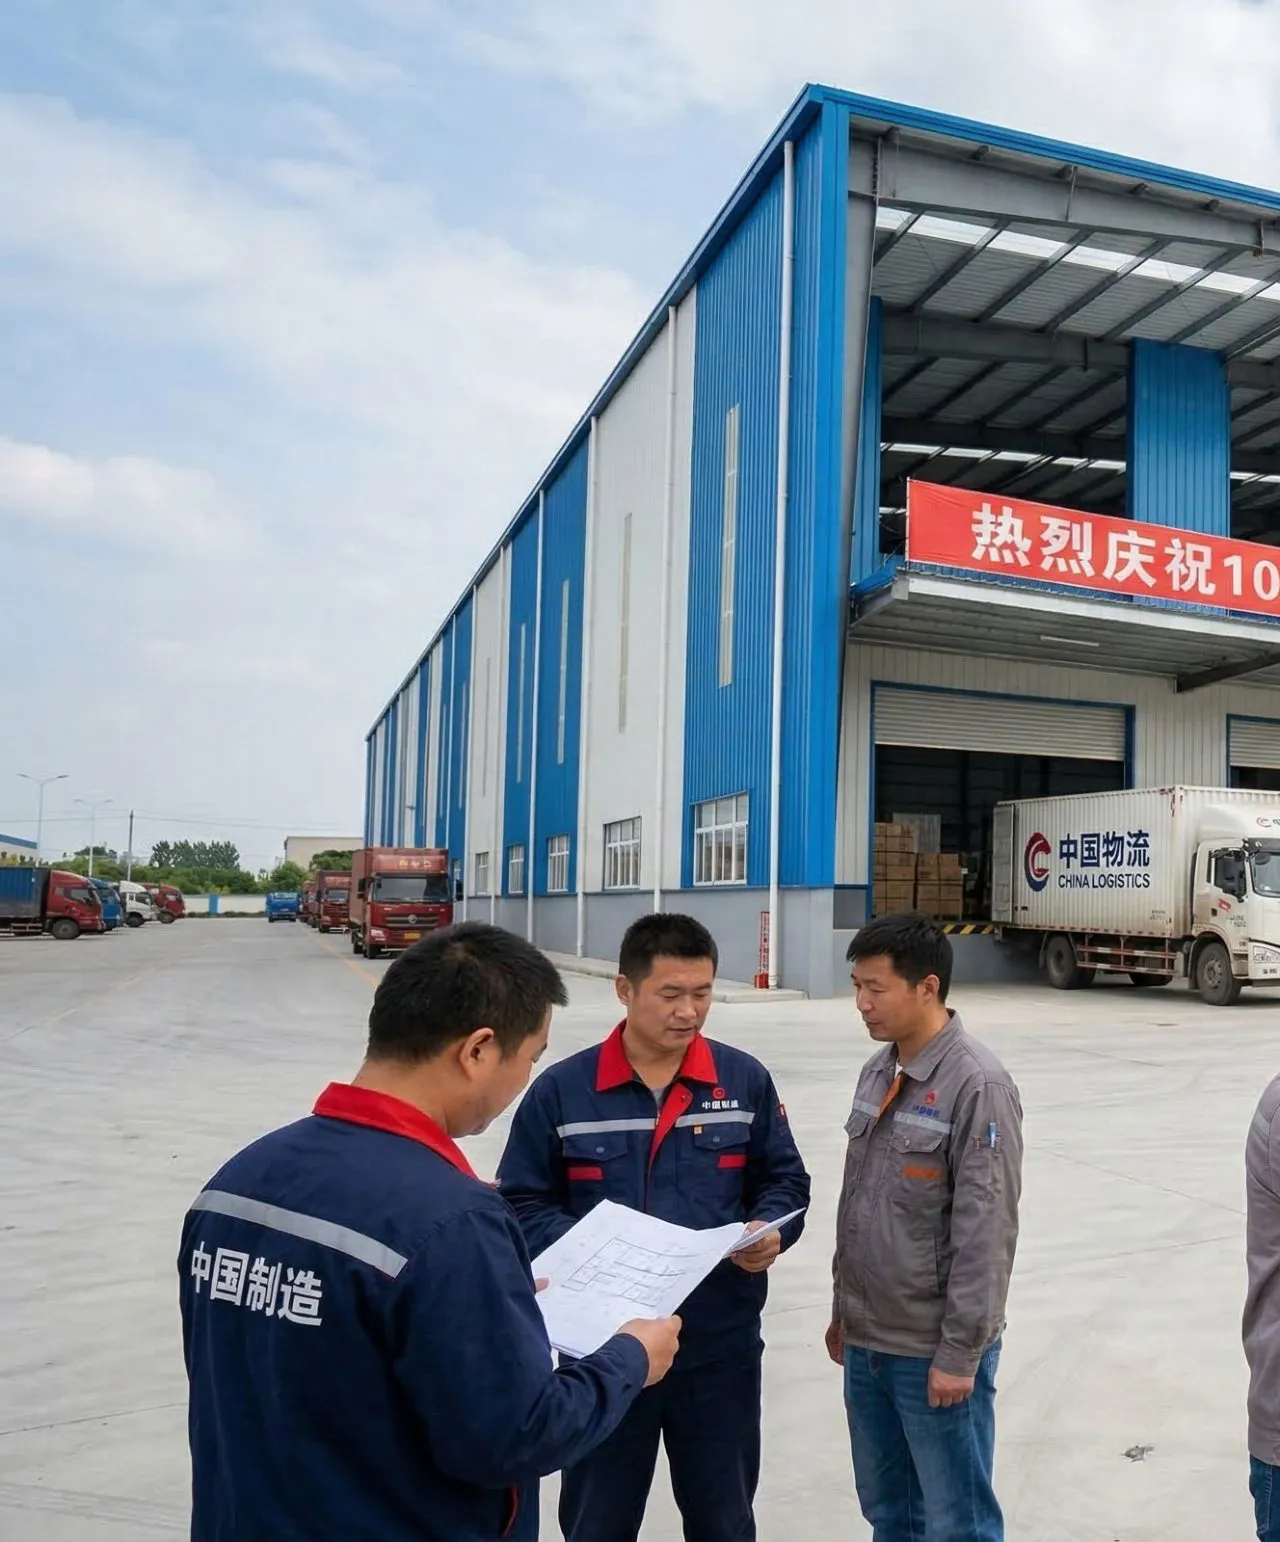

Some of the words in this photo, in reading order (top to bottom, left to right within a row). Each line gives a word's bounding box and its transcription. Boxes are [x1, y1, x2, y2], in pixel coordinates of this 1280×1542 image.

[1058, 829, 1150, 869] 中国物流
[1058, 874, 1090, 889] CHINA
[1091, 873, 1151, 889] LOGISTICS
[191, 1240, 323, 1326] 中国制造
